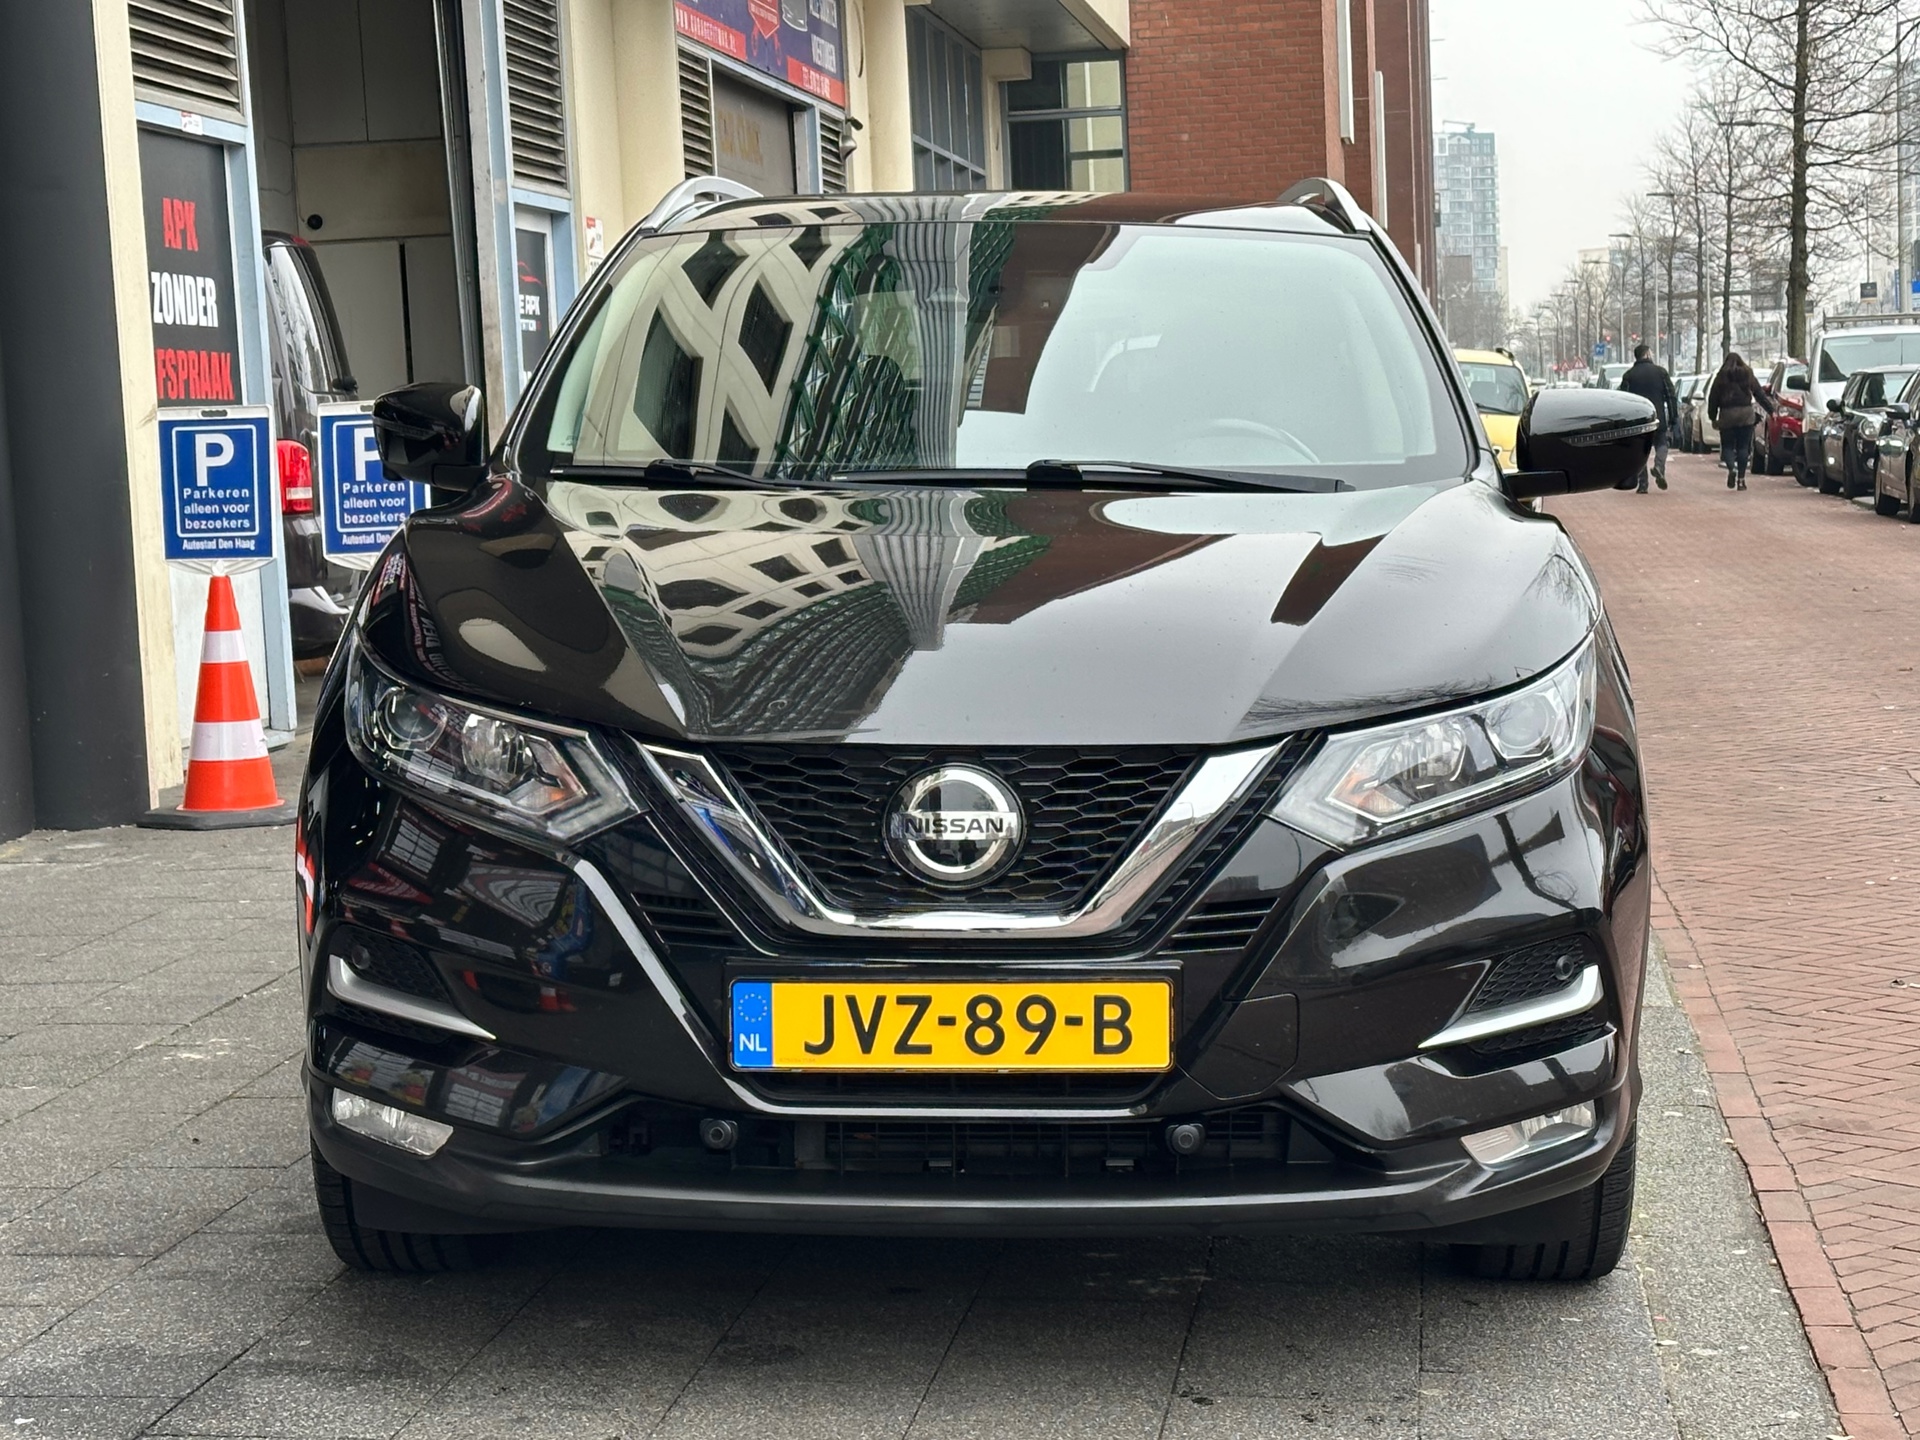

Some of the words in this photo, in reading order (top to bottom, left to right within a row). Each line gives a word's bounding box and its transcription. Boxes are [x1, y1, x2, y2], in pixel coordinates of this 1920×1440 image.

[163, 198, 199, 252] APK
[151, 272, 219, 328] ZONDER
[157, 348, 235, 400] FSPRAAK
[195, 433, 235, 487] P
[183, 487, 250, 499] Parkeren
[342, 482, 406, 494] Parkeren
[184, 503, 219, 514] alleen
[222, 504, 250, 513] voor
[343, 498, 377, 509] alleen
[380, 498, 406, 508] voor
[185, 518, 250, 530] bezoekers
[344, 512, 406, 524] bezoekers
[182, 539, 217, 550] Autostad
[218, 539, 233, 549] Den
[235, 538, 256, 551] Haag
[342, 534, 375, 545] Autostad
[904, 818, 1003, 834] NISSAN
[804, 994, 1133, 1056] JVZ-89-B
[739, 1033, 767, 1052] NL
